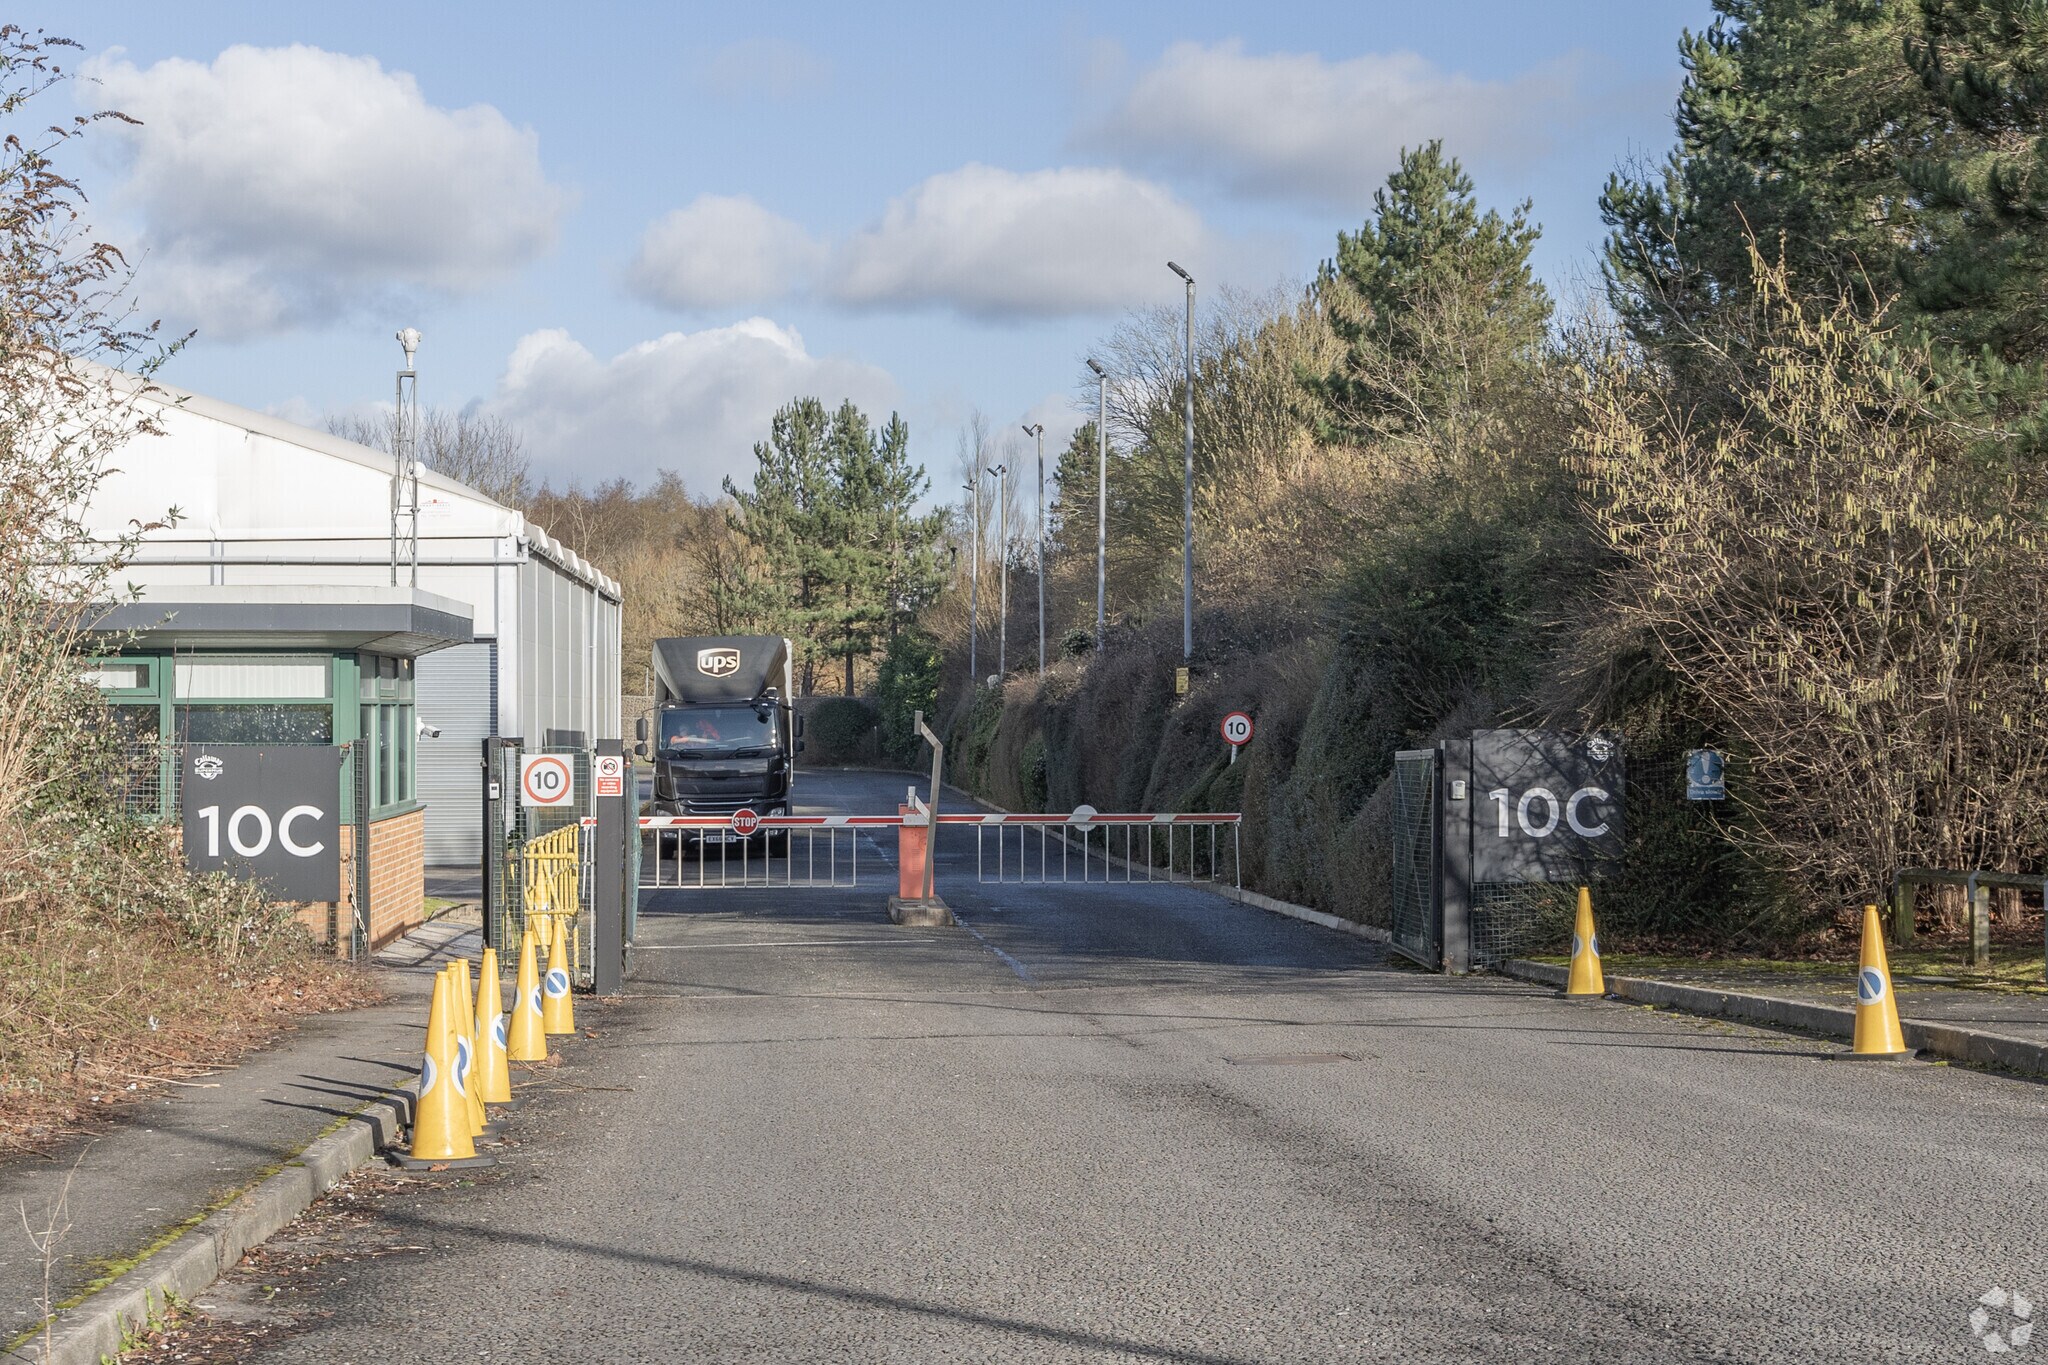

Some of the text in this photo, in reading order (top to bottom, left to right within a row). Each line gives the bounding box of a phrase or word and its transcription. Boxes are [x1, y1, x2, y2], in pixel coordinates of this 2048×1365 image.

[701, 655, 738, 673] ups
[1228, 722, 1247, 735] 10
[534, 771, 559, 789] 10
[1488, 787, 1610, 837] 10C
[198, 805, 325, 857] 10C
[734, 817, 756, 827] STOP
